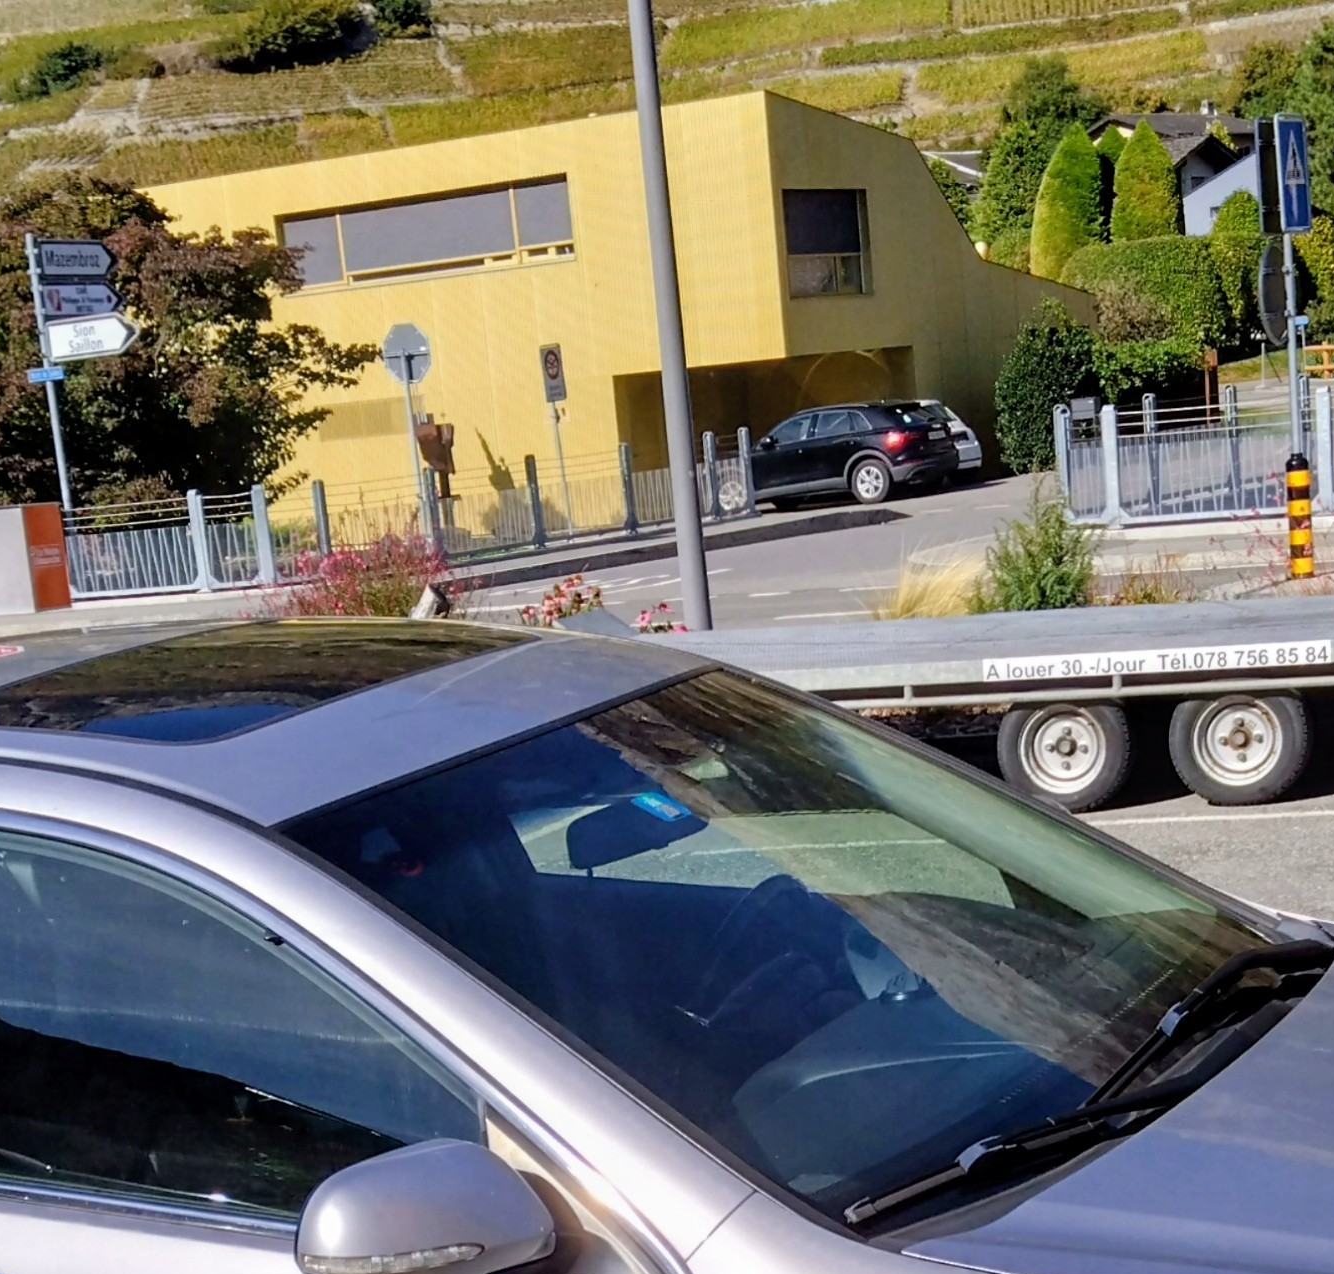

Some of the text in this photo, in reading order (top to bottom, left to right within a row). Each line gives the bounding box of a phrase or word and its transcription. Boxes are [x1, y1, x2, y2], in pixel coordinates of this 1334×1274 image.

[45, 250, 100, 268] Mazembroz
[73, 325, 96, 338] Sion
[69, 339, 104, 353] Saillon
[1007, 663, 1055, 679] louer
[1234, 649, 1269, 666] 756
[1276, 648, 1299, 664] 85
[1305, 646, 1329, 663] 84
